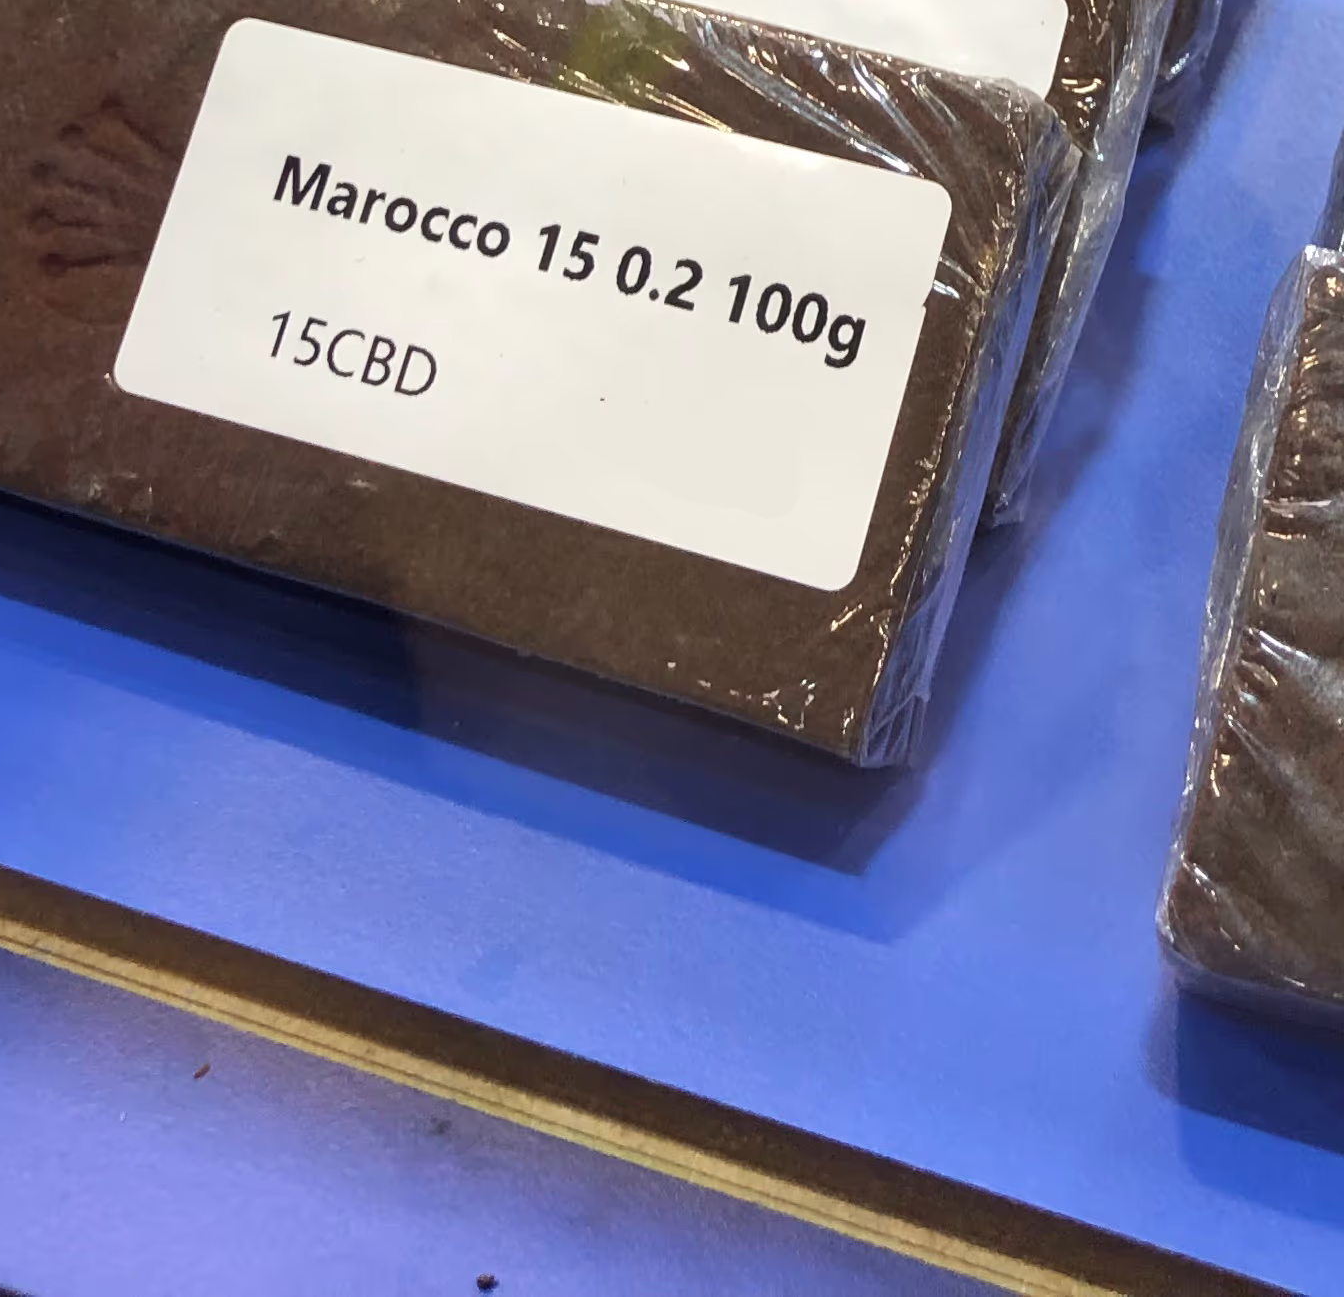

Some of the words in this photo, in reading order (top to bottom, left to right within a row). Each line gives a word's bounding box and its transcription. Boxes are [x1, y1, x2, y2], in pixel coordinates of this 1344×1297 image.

[272, 155, 511, 258] Marocco
[536, 223, 601, 281] 15
[615, 245, 704, 312] 0.2
[727, 273, 866, 369] 100g
[268, 310, 438, 397] 15CBD
